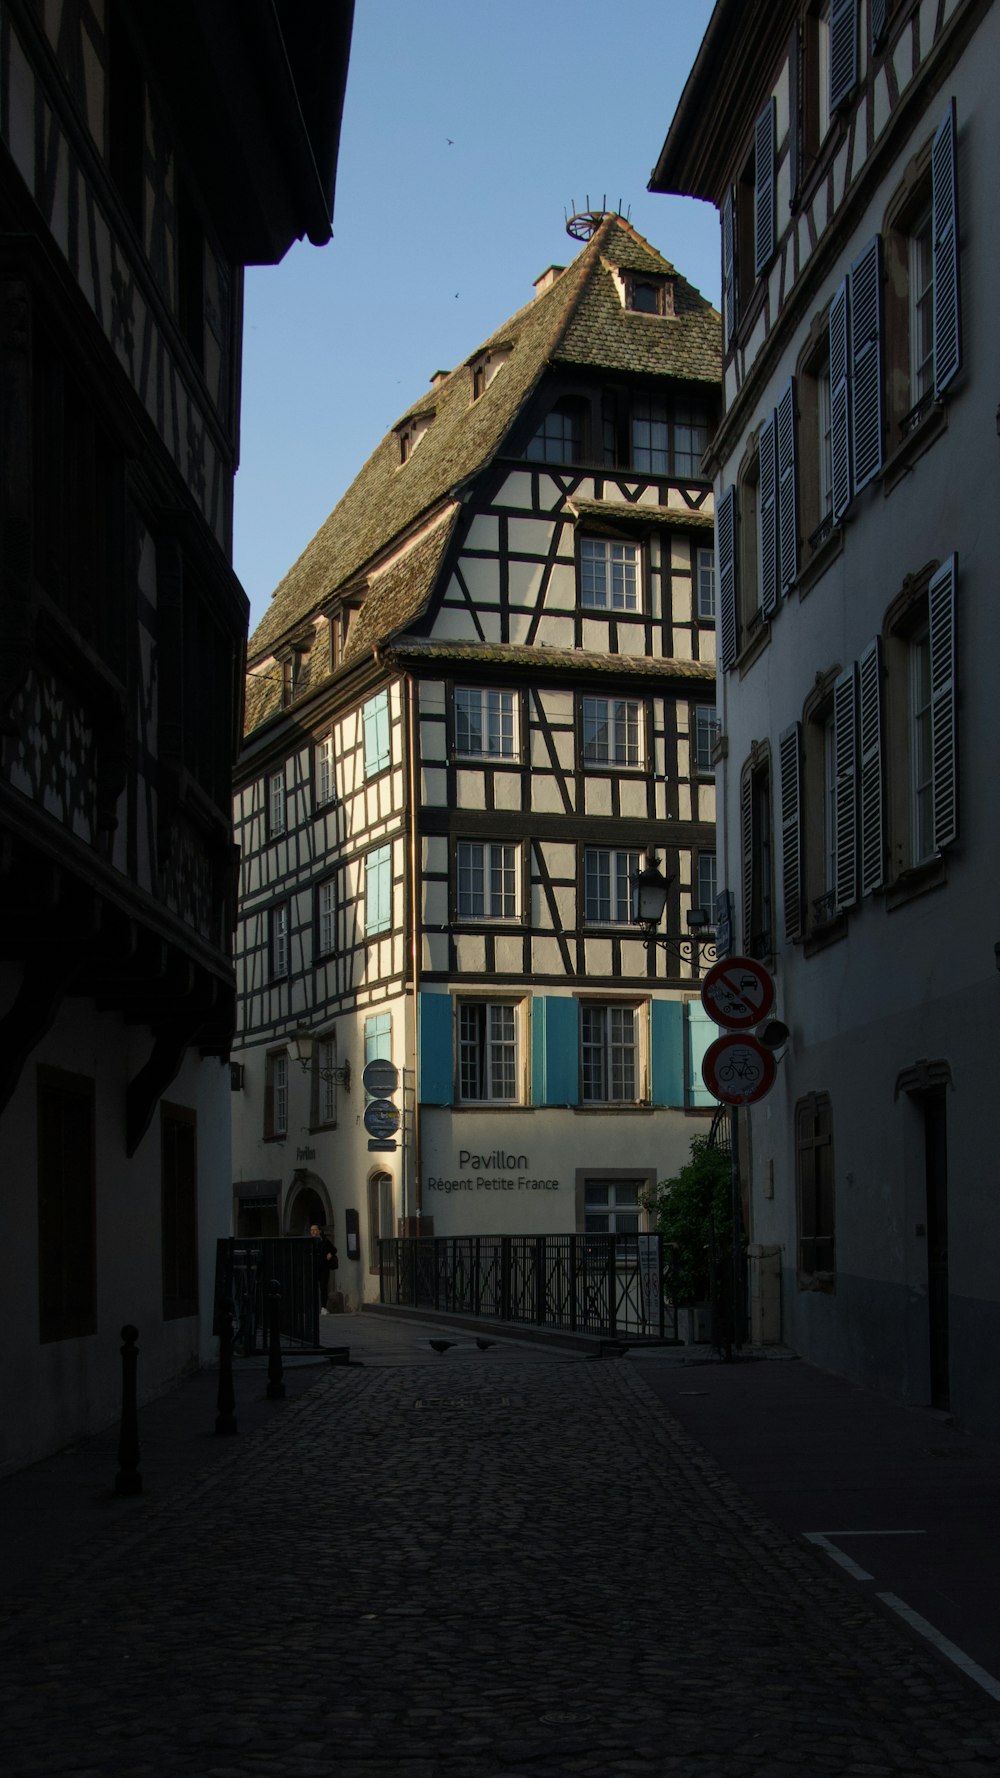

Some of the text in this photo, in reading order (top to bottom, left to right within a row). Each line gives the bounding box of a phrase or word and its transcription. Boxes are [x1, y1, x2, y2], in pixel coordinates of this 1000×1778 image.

[296, 1146, 316, 1161] Pavillon
[459, 1150, 528, 1170] Pavillon
[428, 1176, 559, 1194] Régent Petite France
